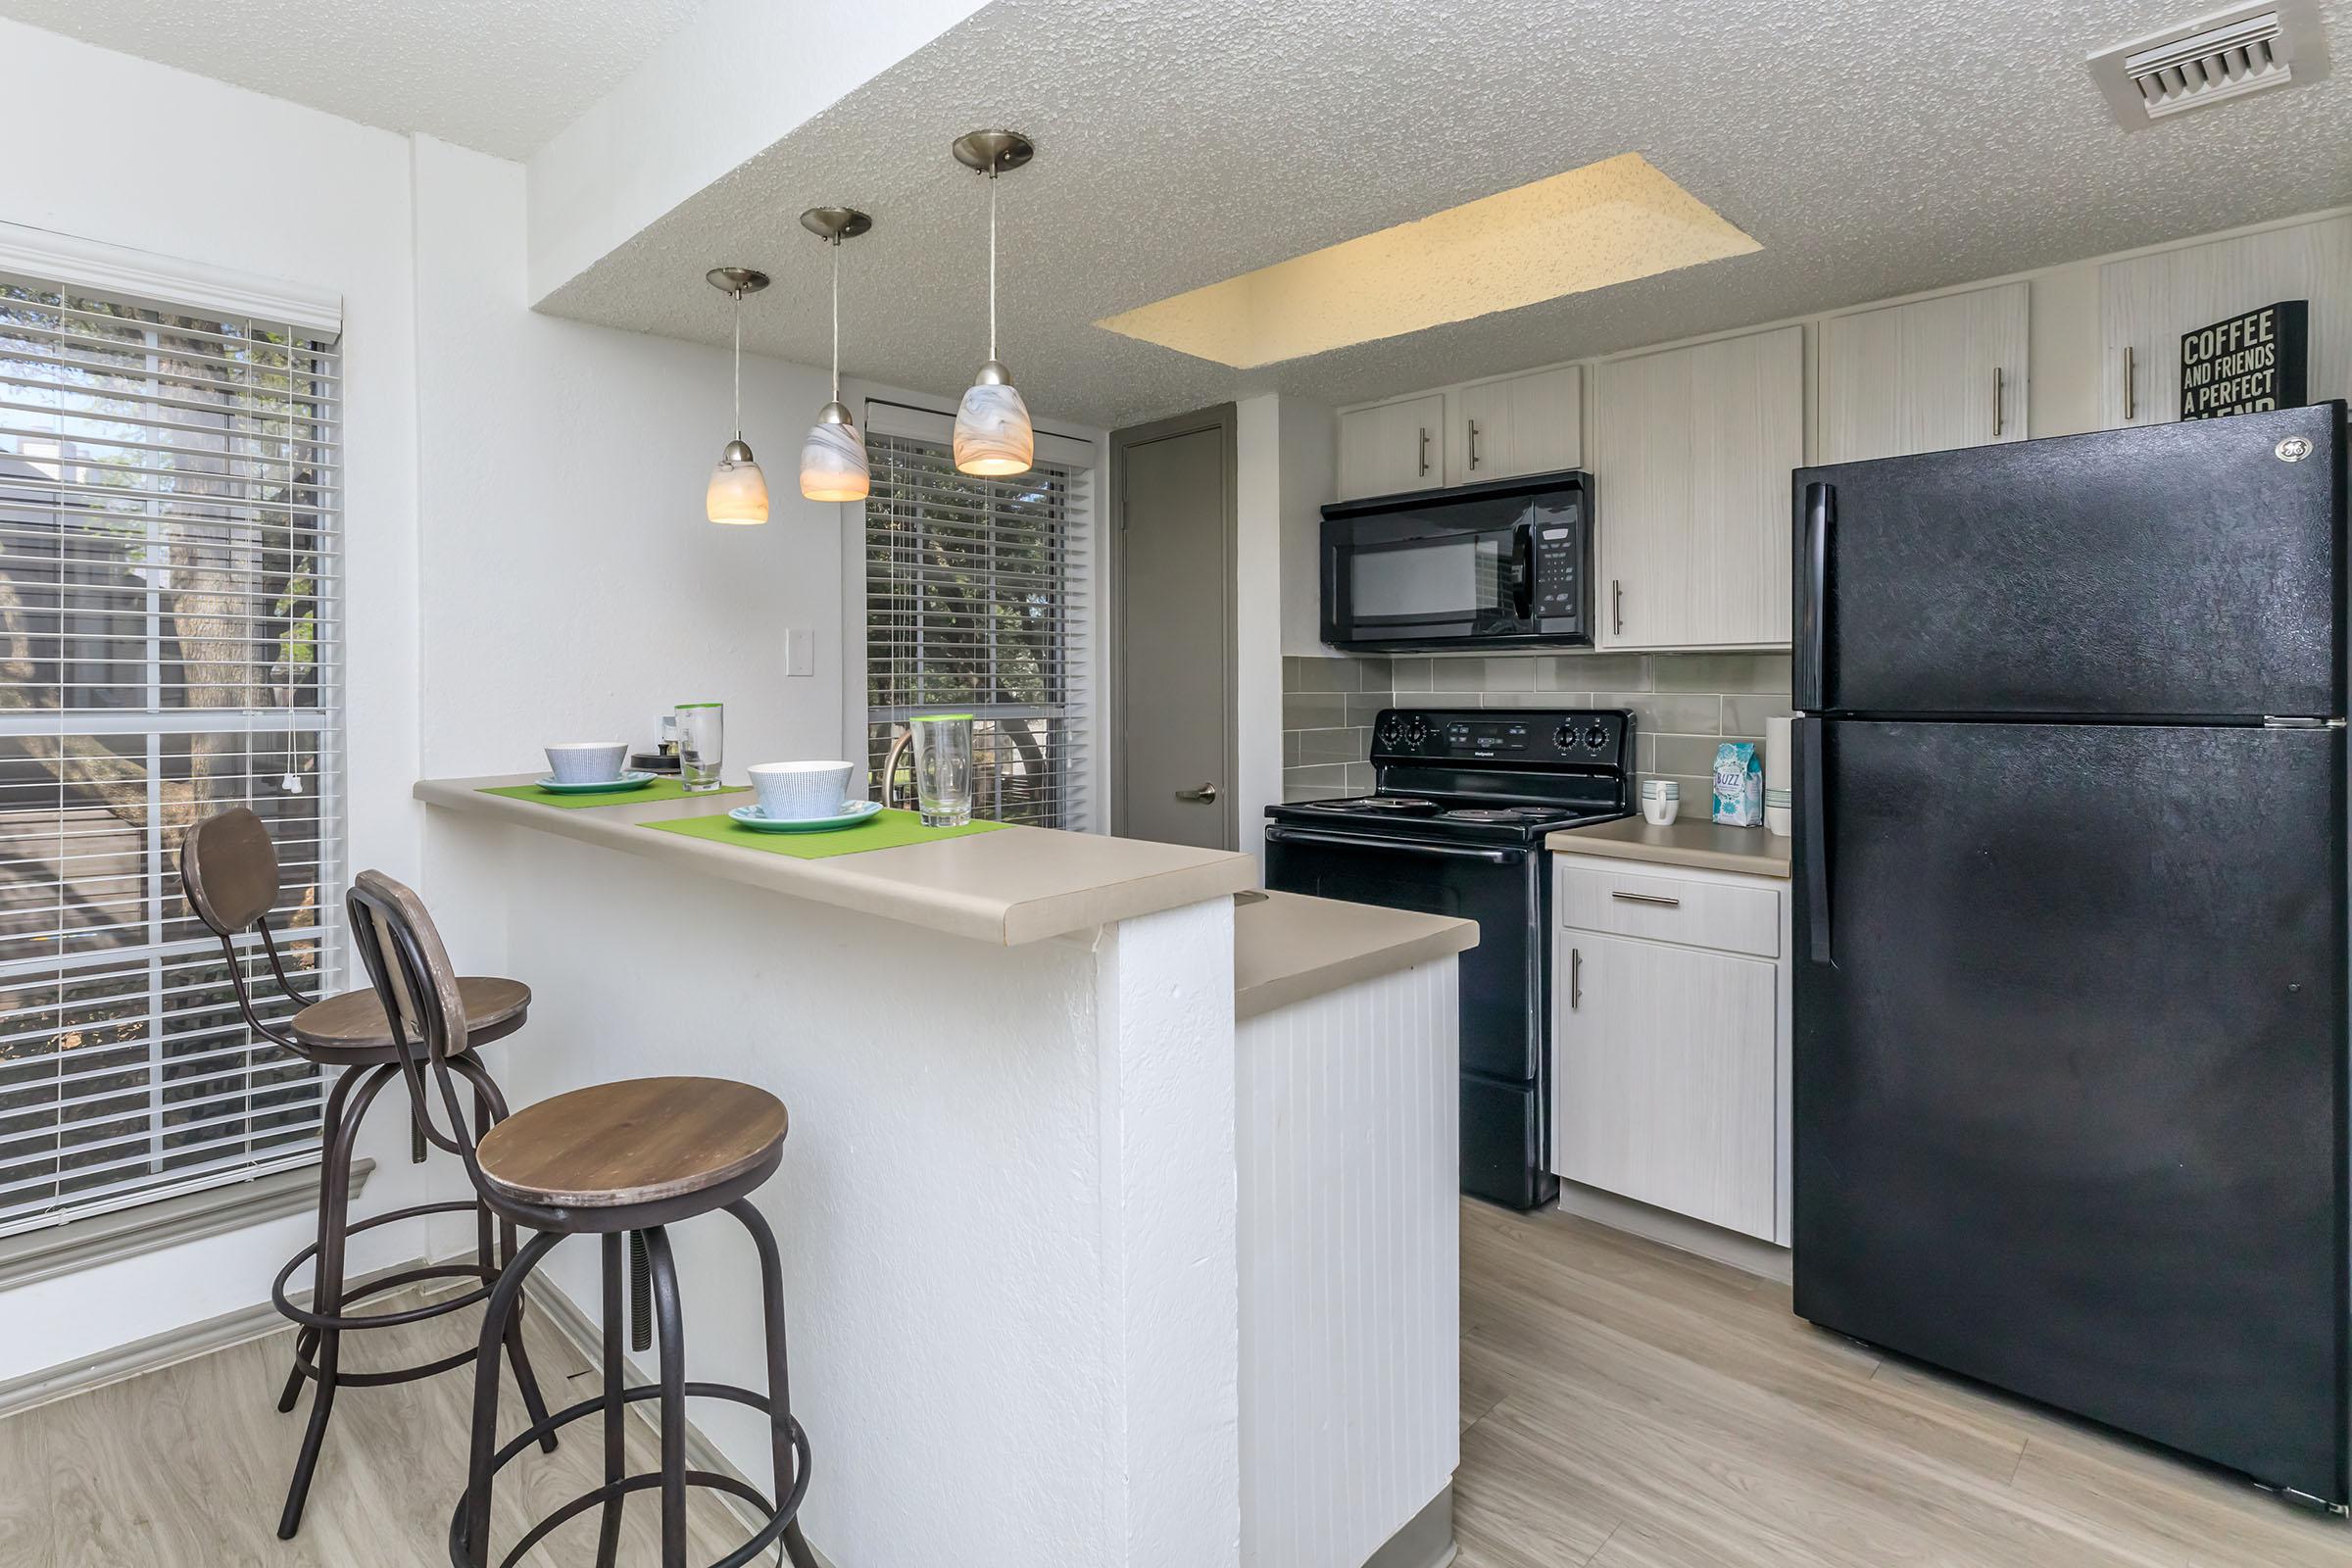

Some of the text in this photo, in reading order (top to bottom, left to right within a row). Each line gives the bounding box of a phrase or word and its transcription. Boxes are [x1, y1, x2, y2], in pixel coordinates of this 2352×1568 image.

[2183, 309, 2274, 365] COFFEE
[2183, 343, 2275, 389] AND FRIENDS
[2184, 391, 2194, 415] A
[2199, 368, 2275, 411] PERFECT
[1717, 772, 1740, 786] BUZZ
